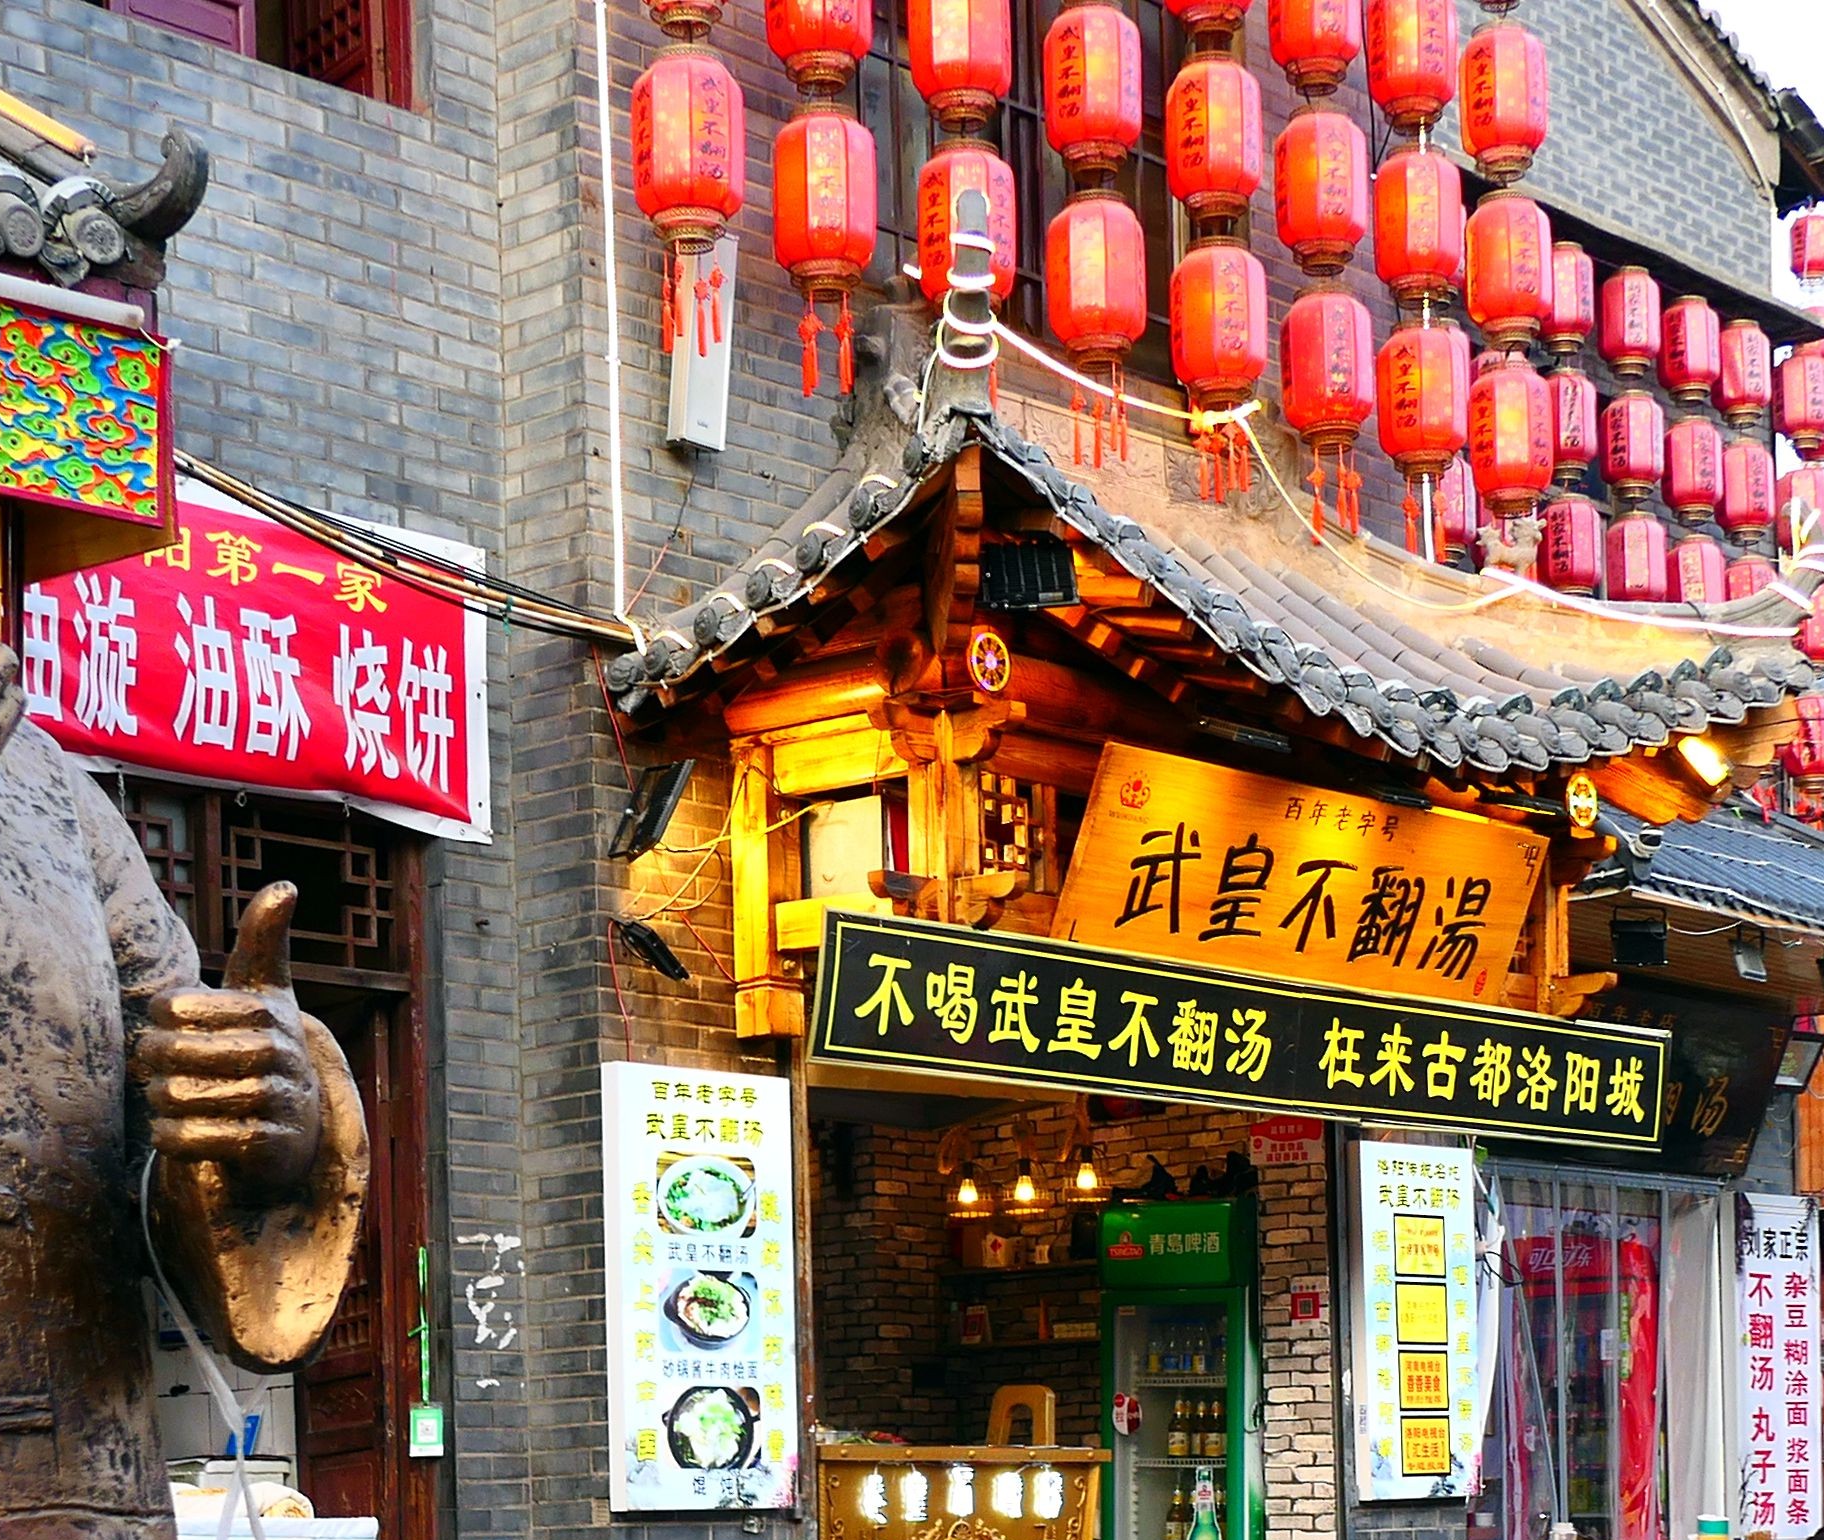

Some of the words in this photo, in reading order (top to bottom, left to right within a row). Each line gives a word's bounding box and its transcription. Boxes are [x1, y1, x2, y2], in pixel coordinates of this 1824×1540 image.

[172, 593, 312, 763] 油酥
[332, 622, 456, 795] 烧饼
[1282, 796, 1402, 842] 百年老字号
[1114, 822, 1492, 983] 武皇不翻湯
[853, 953, 1272, 1084] 不喝武皇不翻汤
[1319, 1018, 1647, 1123] 枉来古都洛阳城
[650, 1080, 760, 1110] 百年老字号
[646, 1113, 765, 1148] 武皇不翻汤
[1743, 1228, 1809, 1261] 刘家正宗
